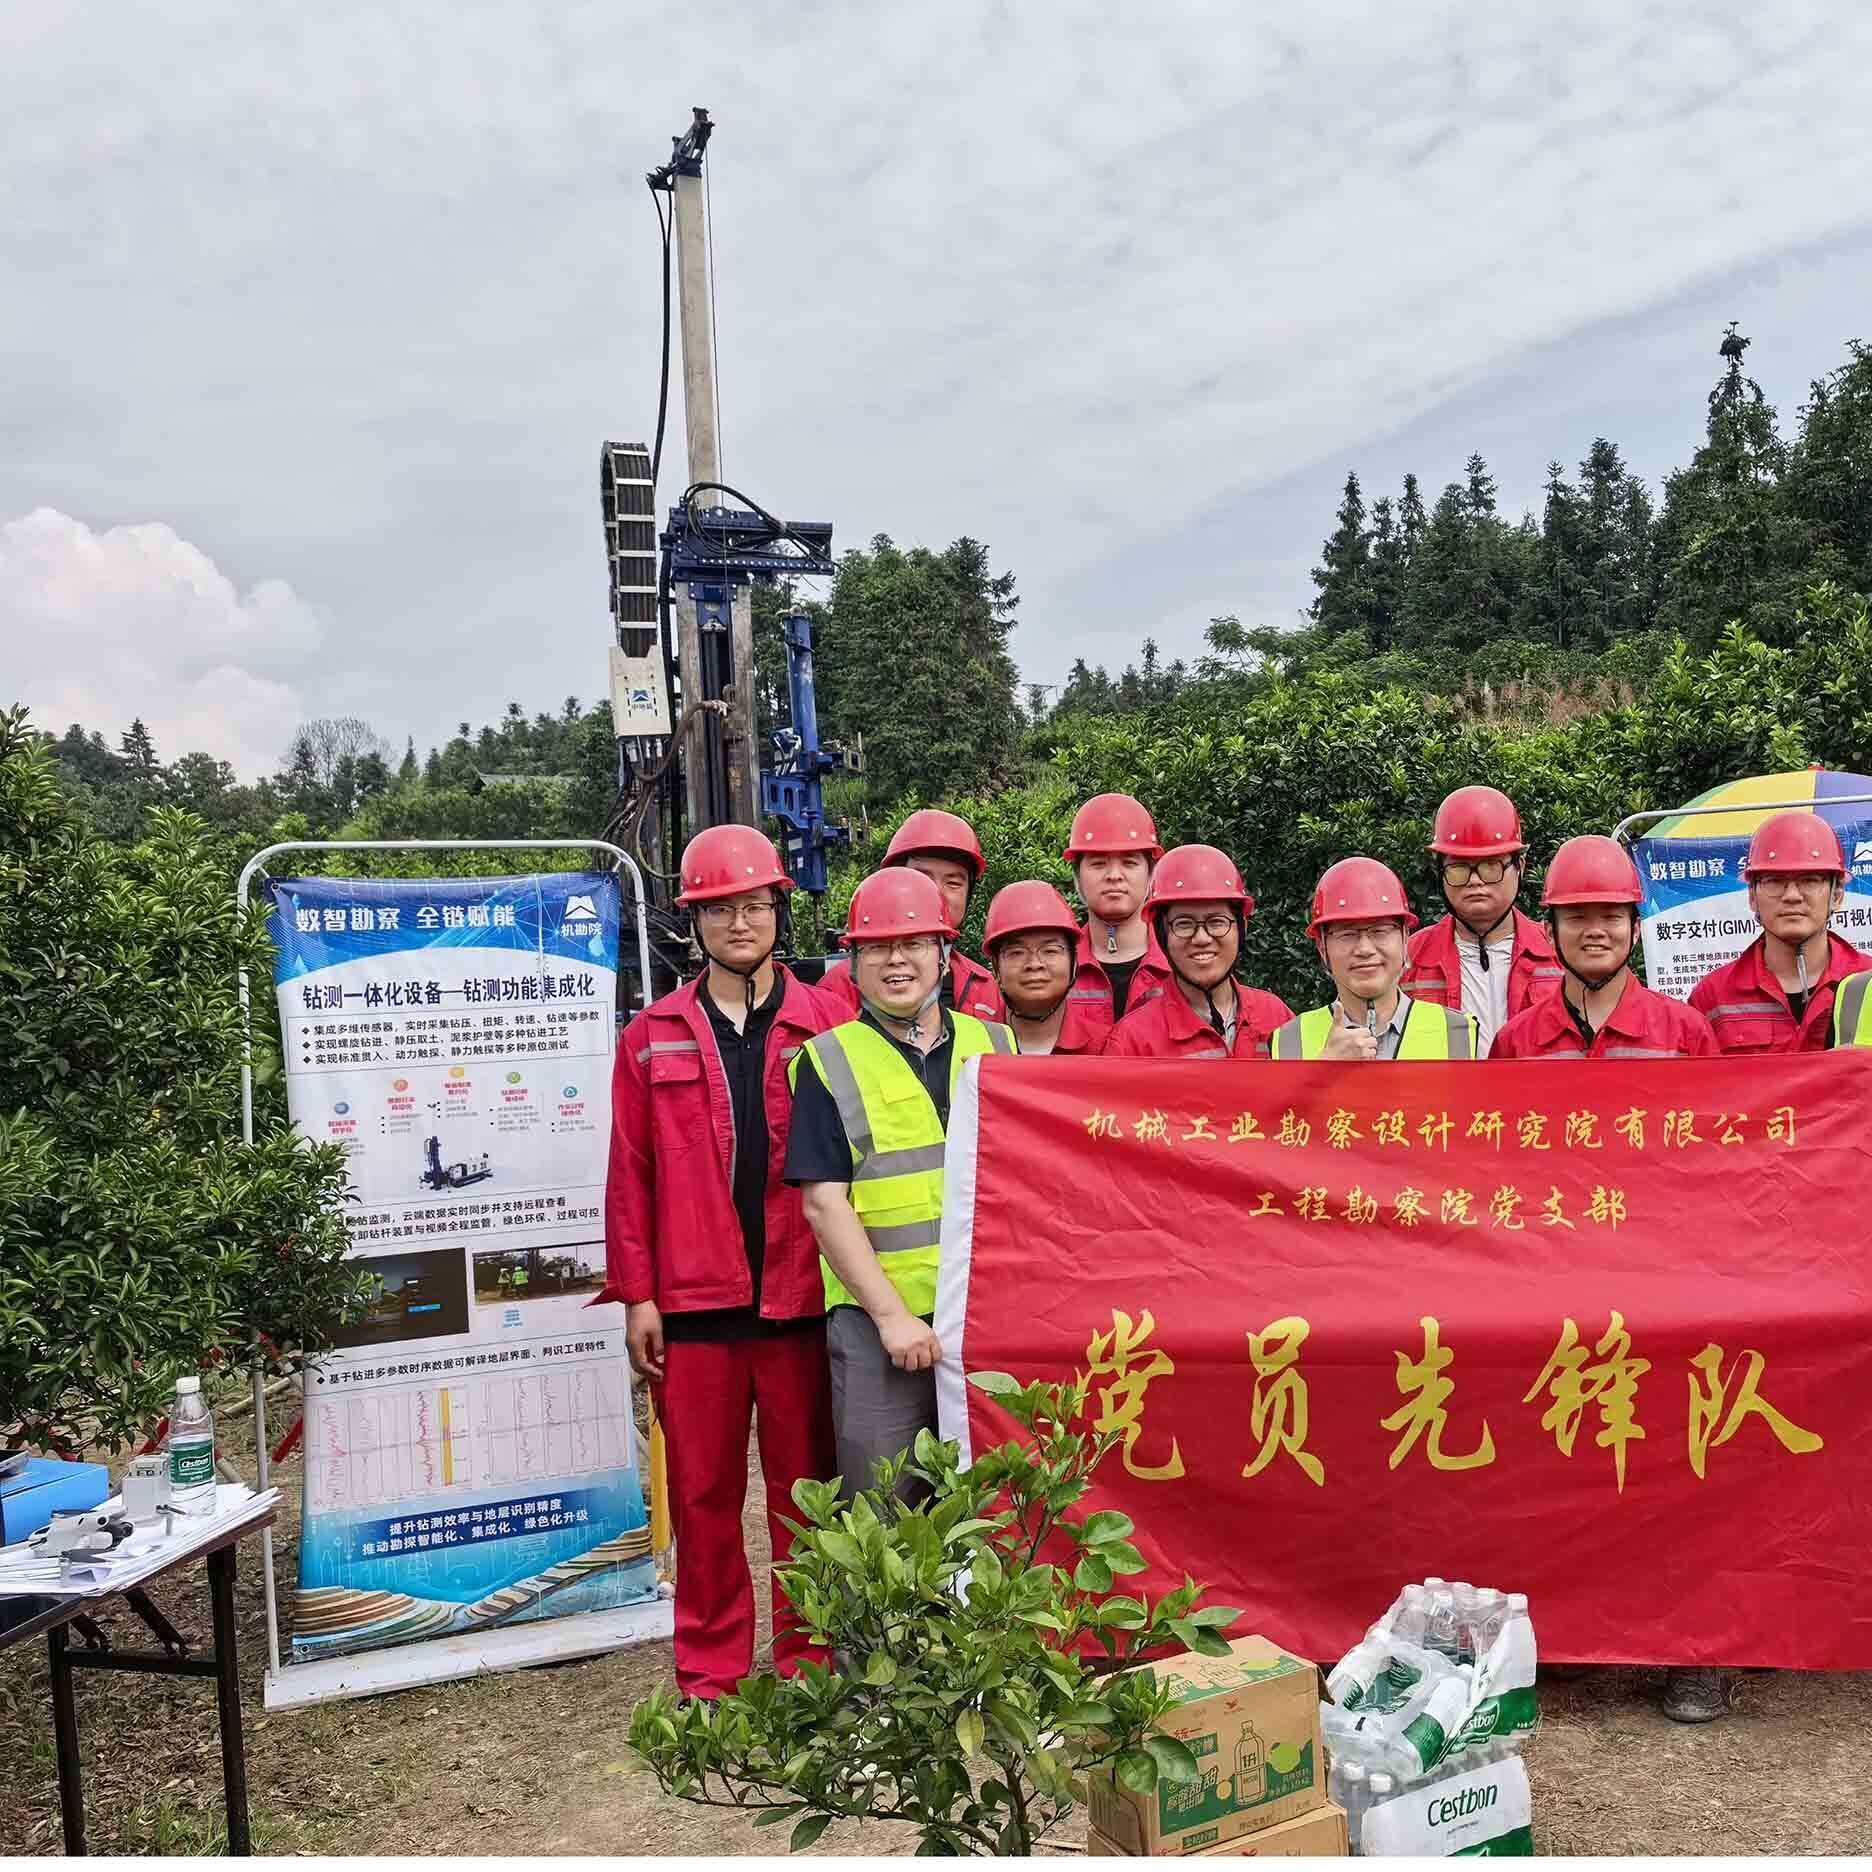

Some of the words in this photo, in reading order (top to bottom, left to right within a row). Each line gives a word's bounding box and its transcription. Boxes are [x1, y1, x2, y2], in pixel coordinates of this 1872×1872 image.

[1650, 858, 1725, 881] 数智勘察
[296, 907, 401, 932] 数智勘察
[416, 904, 516, 930] 全链赋能
[560, 922, 603, 937] 机勘院
[1085, 1106, 1800, 1154] 机械工业勘察设计研究院有限公司
[1248, 1186, 1631, 1234] 工程勘察院党支部
[1074, 1306, 1824, 1494] 党员先锋队
[361, 1510, 589, 1556] 推动勘探智能化、集成化、绿色化升级
[389, 1498, 563, 1535] 提升钻测效率与地层识别精度
[1427, 1784, 1498, 1828] C'estbon
